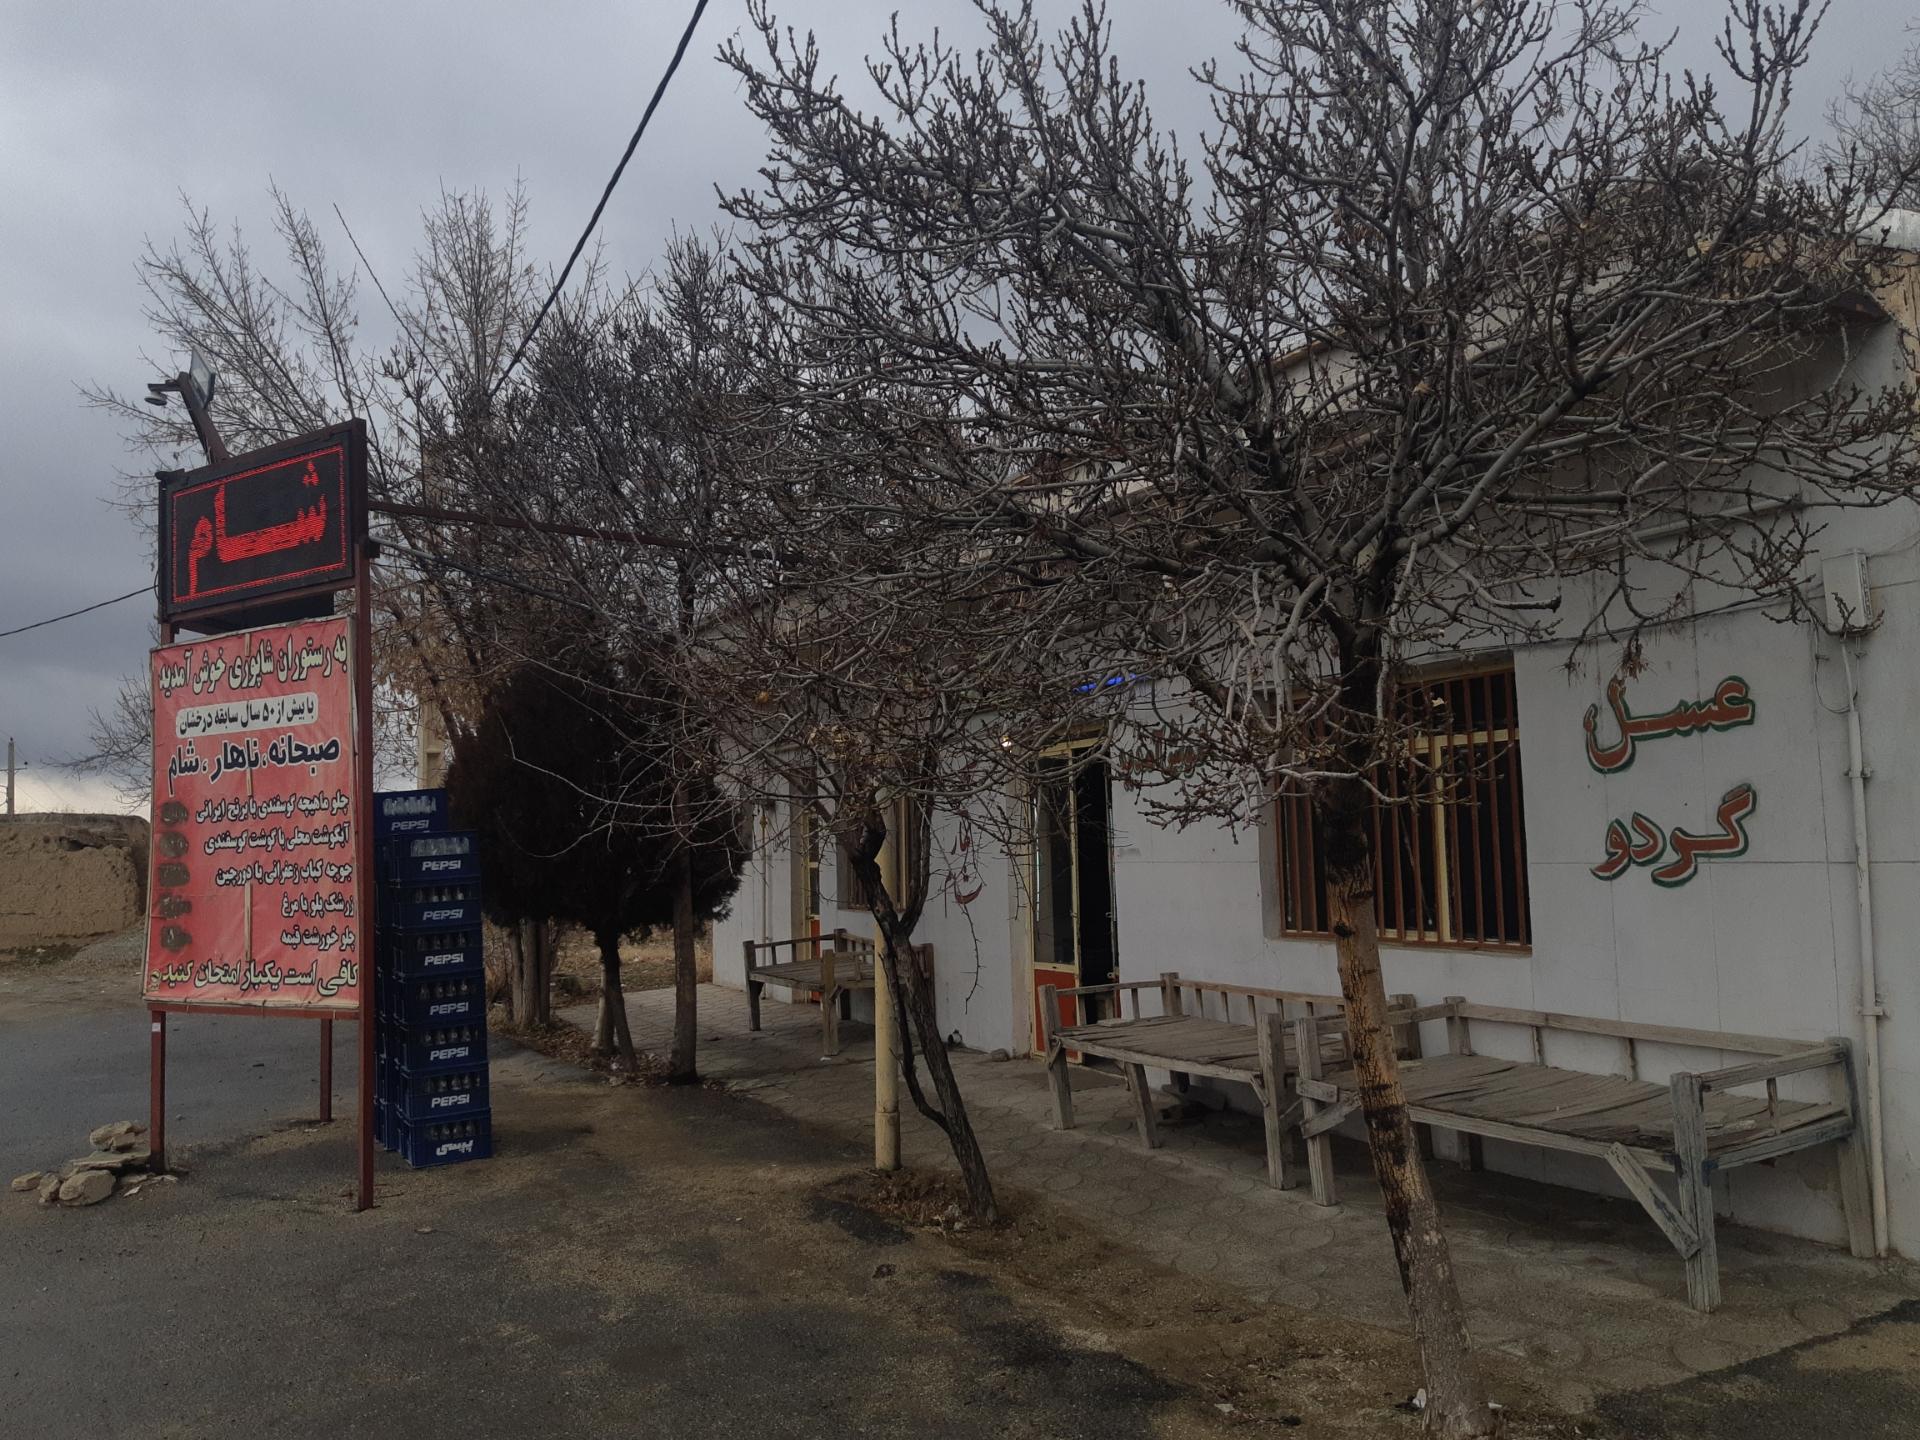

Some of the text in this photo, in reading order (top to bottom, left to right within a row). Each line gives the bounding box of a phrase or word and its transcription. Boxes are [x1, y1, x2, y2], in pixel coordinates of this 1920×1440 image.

[188, 461, 327, 596] شام
[159, 635, 348, 698] به رستوران شاپوری خوش آمدید
[179, 698, 314, 735] با بیش از ۵۰ سال سابقه درخشان
[1583, 675, 1756, 774] عسل
[168, 737, 200, 796] شام
[196, 799, 226, 823] ایرانی
[227, 801, 249, 820] برنج
[249, 797, 256, 815] با
[259, 793, 296, 819] گوسفندی
[298, 795, 329, 818] ماهیچه
[331, 791, 349, 817] چلو
[313, 822, 350, 848] آبگوشت
[391, 819, 430, 831] PEPSI
[1589, 783, 1757, 888] گردو
[204, 831, 249, 855] گوسفندی
[249, 830, 278, 851] گوشت
[278, 829, 286, 851] با
[287, 826, 311, 850] محلی
[254, 864, 263, 884] با
[265, 861, 300, 884] زعفرانی
[302, 859, 323, 883] کباب
[325, 862, 353, 883] جوجه
[421, 859, 462, 872] PEPSI
[281, 892, 299, 918] مرغ
[300, 896, 309, 916] با
[310, 895, 323, 918] پلو
[422, 908, 464, 921] PEPSI
[281, 925, 356, 950] چلو خورشت قیمه
[424, 952, 464, 966] PEPSI
[162, 962, 194, 989] کنید
[195, 959, 241, 988] امتحان
[240, 959, 283, 991] یکبار
[283, 959, 317, 985] است
[429, 1001, 469, 1016] PEPSI
[429, 1046, 469, 1061] PEPSI
[431, 1093, 470, 1109] PEPSI
